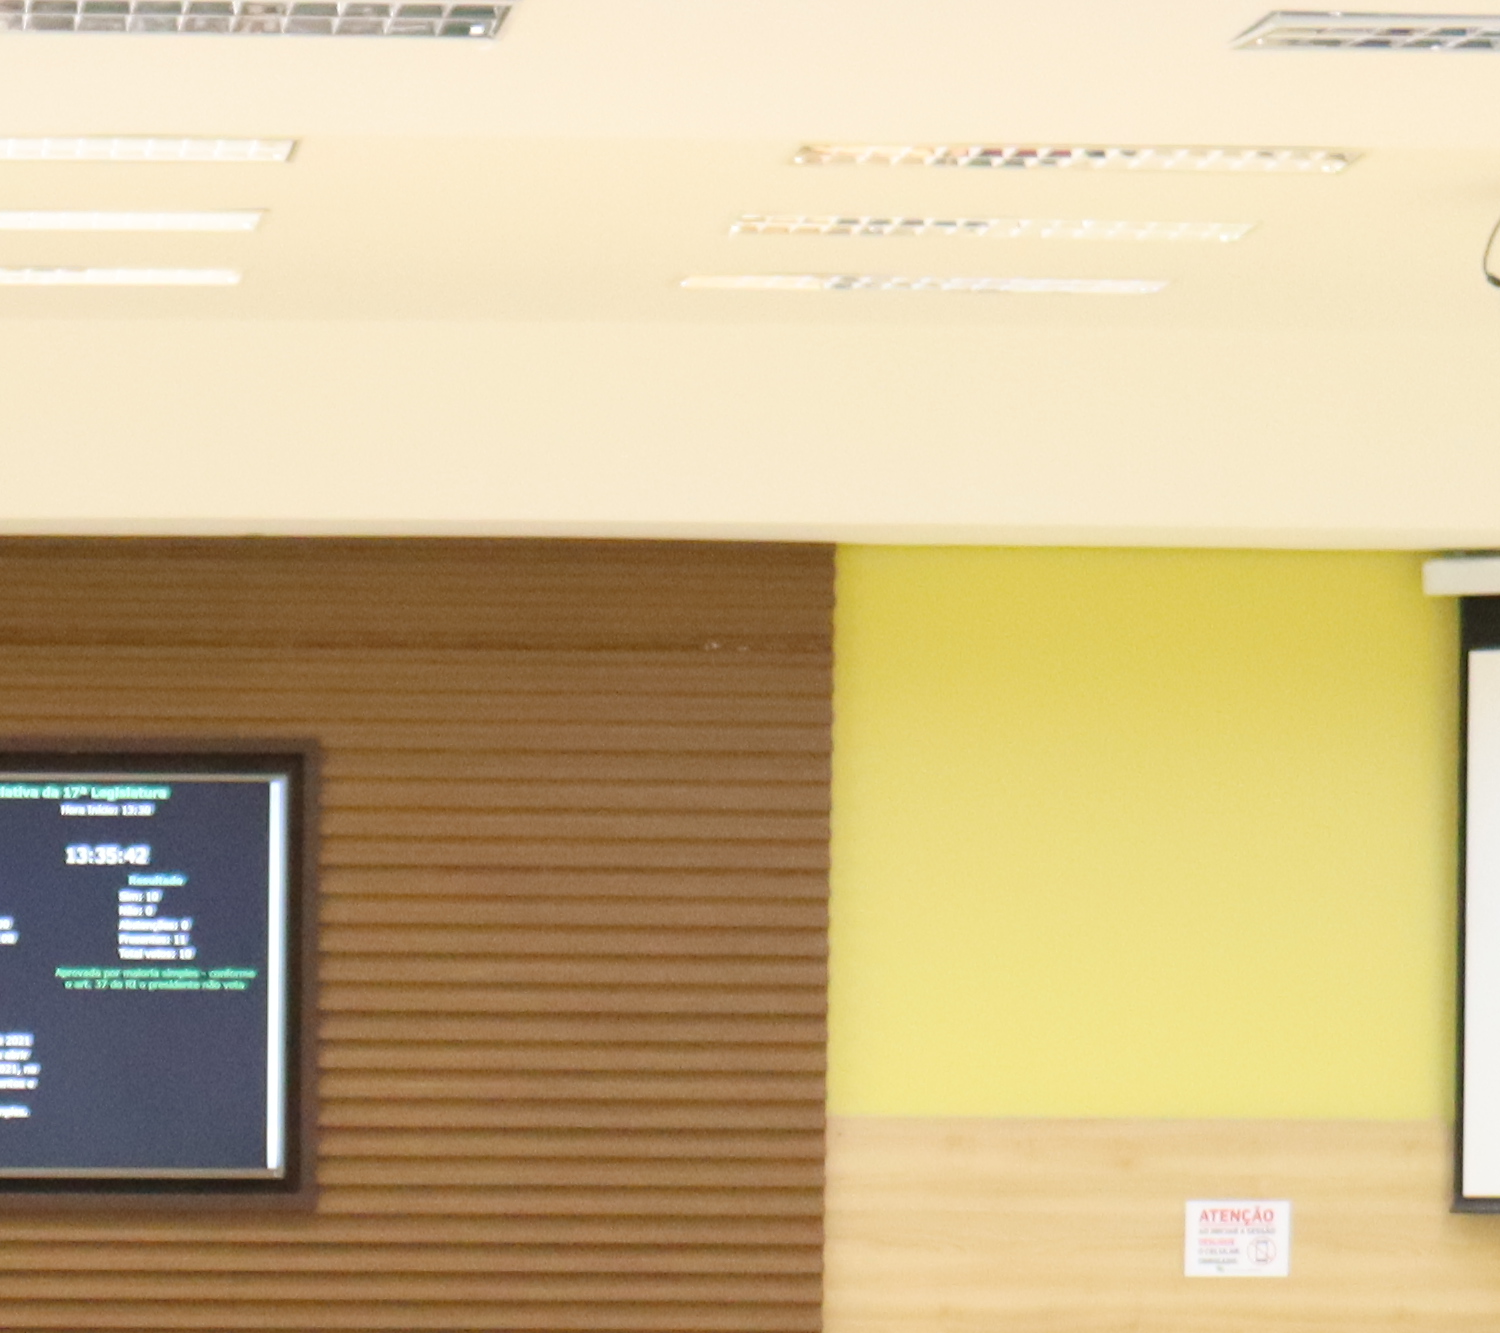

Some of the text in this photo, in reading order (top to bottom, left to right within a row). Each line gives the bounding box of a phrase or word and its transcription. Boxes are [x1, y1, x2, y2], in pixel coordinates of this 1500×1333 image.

[41, 786, 62, 799] da
[63, 785, 89, 799] 17ª
[89, 786, 169, 801] Legislatura
[66, 845, 150, 865] 13:35:42
[1200, 1205, 1274, 1226] ATENÇÃO
